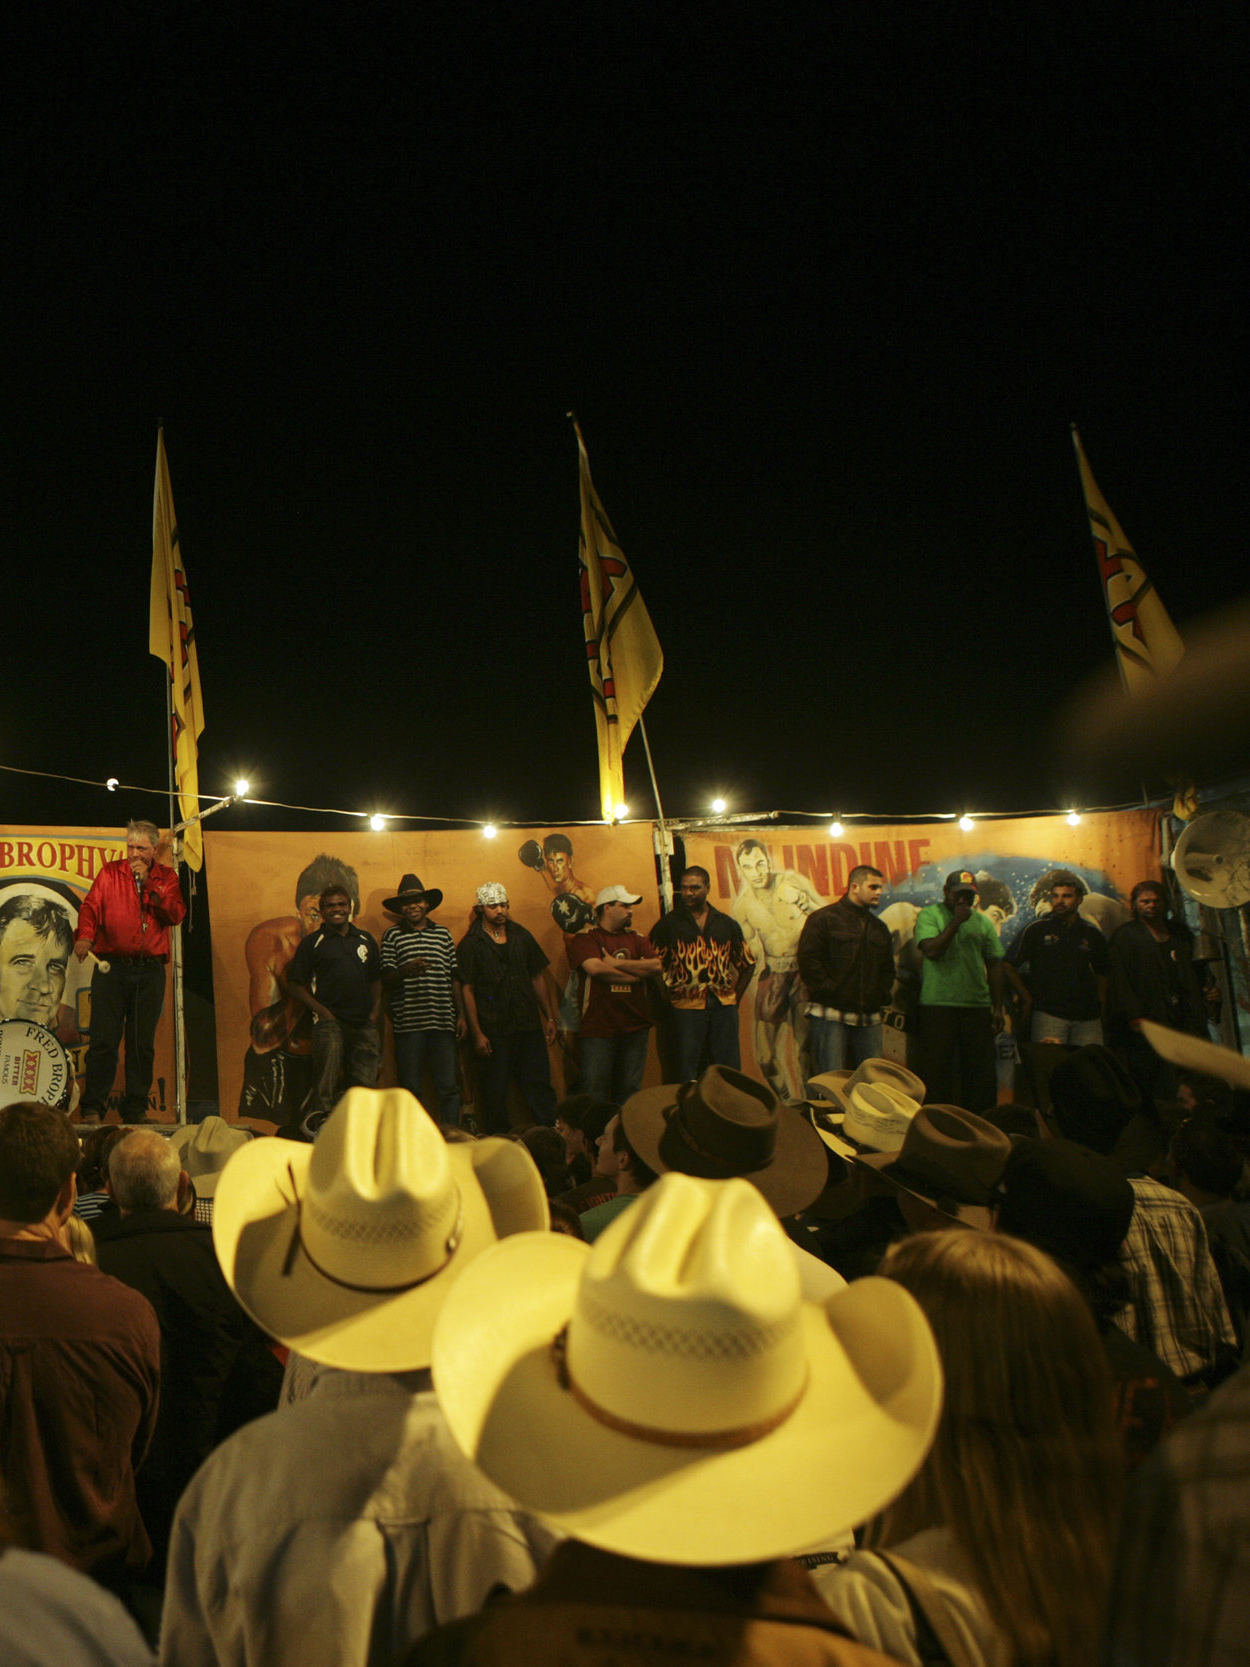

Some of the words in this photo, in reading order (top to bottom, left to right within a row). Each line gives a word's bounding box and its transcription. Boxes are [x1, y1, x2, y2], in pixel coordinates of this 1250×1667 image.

[26, 1027, 59, 1059] FRED
[2, 1054, 11, 1085] FAMOUS
[12, 1056, 21, 1086] BITTER
[22, 1053, 38, 1091] XXXX
